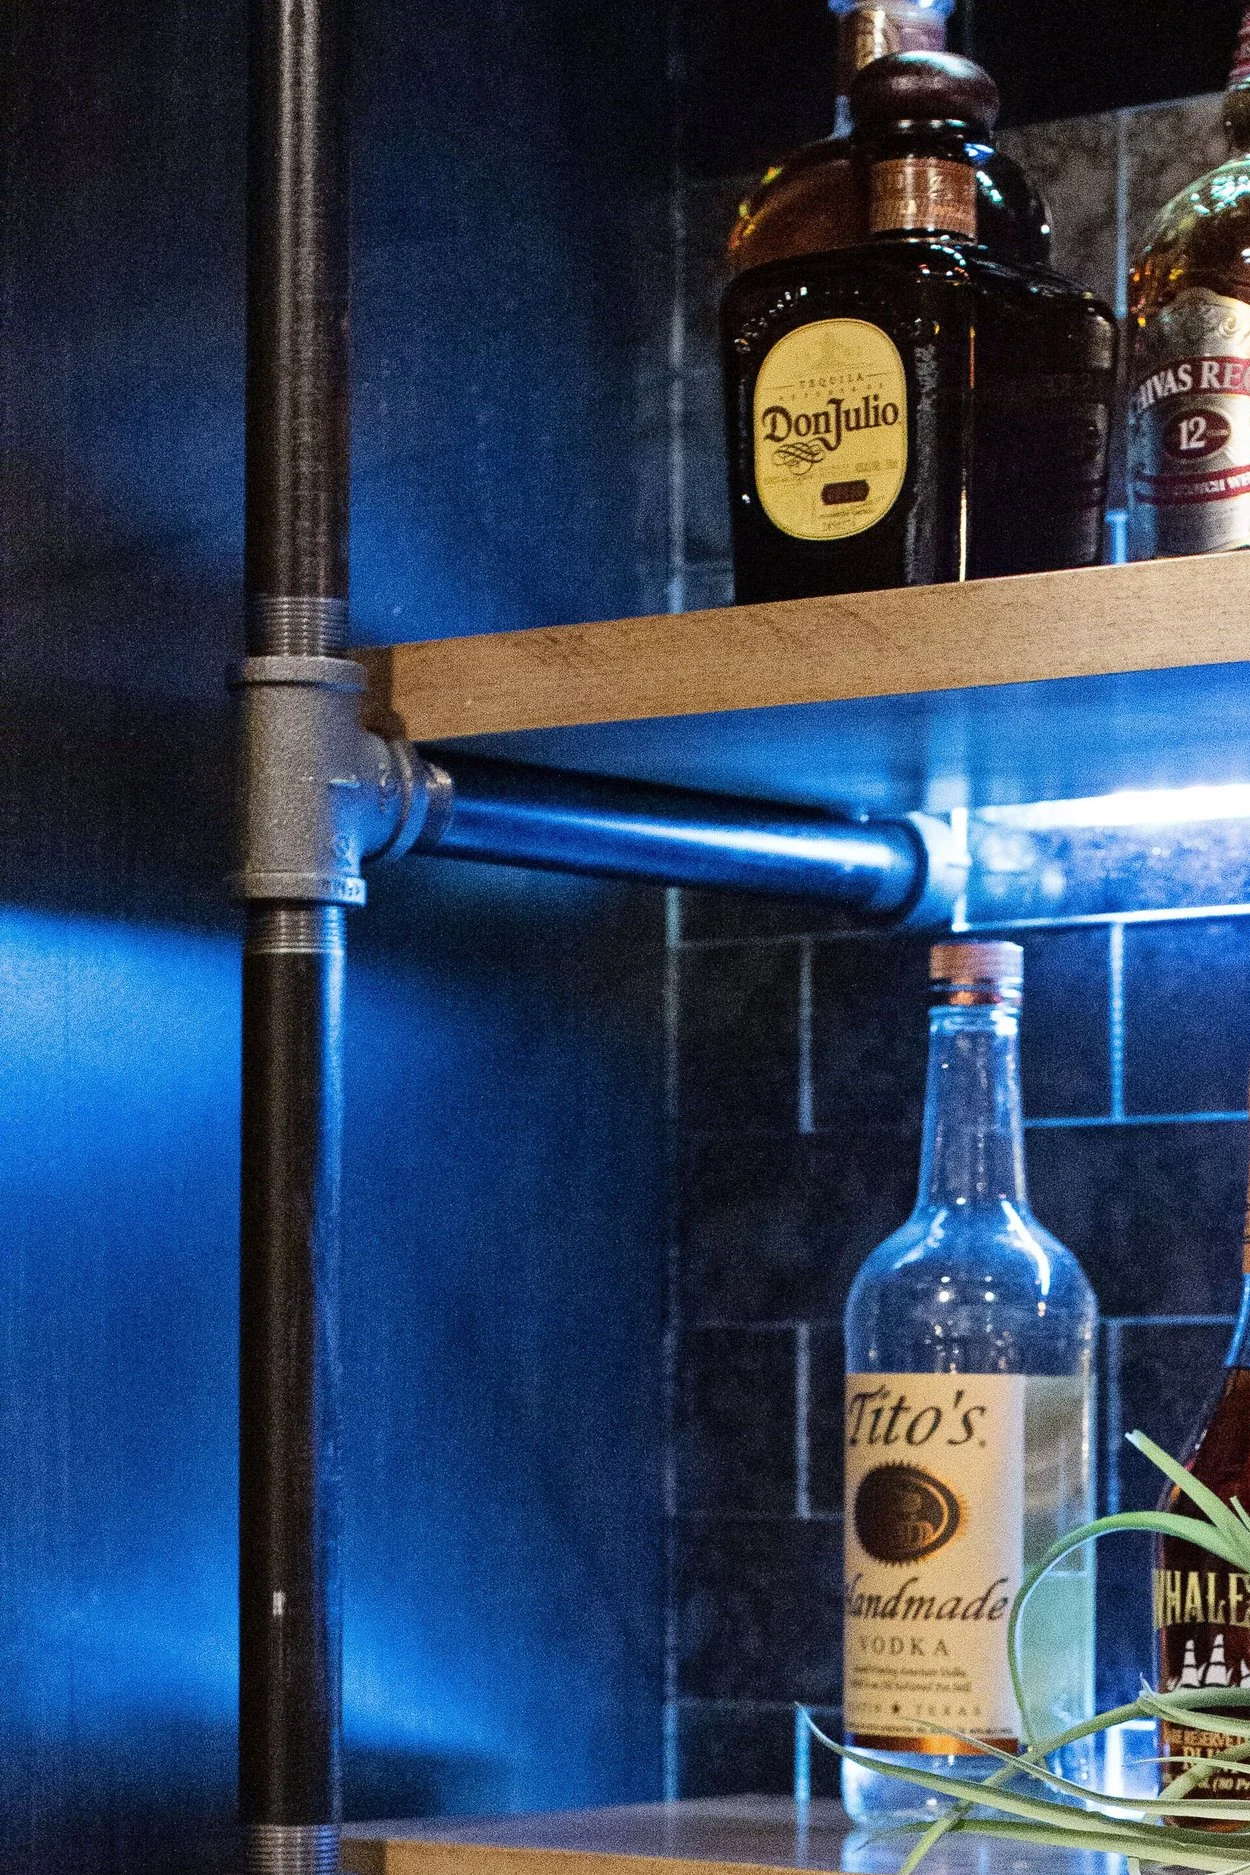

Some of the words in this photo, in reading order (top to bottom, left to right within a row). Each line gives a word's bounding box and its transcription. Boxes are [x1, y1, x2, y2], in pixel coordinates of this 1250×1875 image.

[1136, 364, 1193, 413] IVAS
[1178, 416, 1207, 450] 12
[856, 1636, 950, 1657] VODKA
